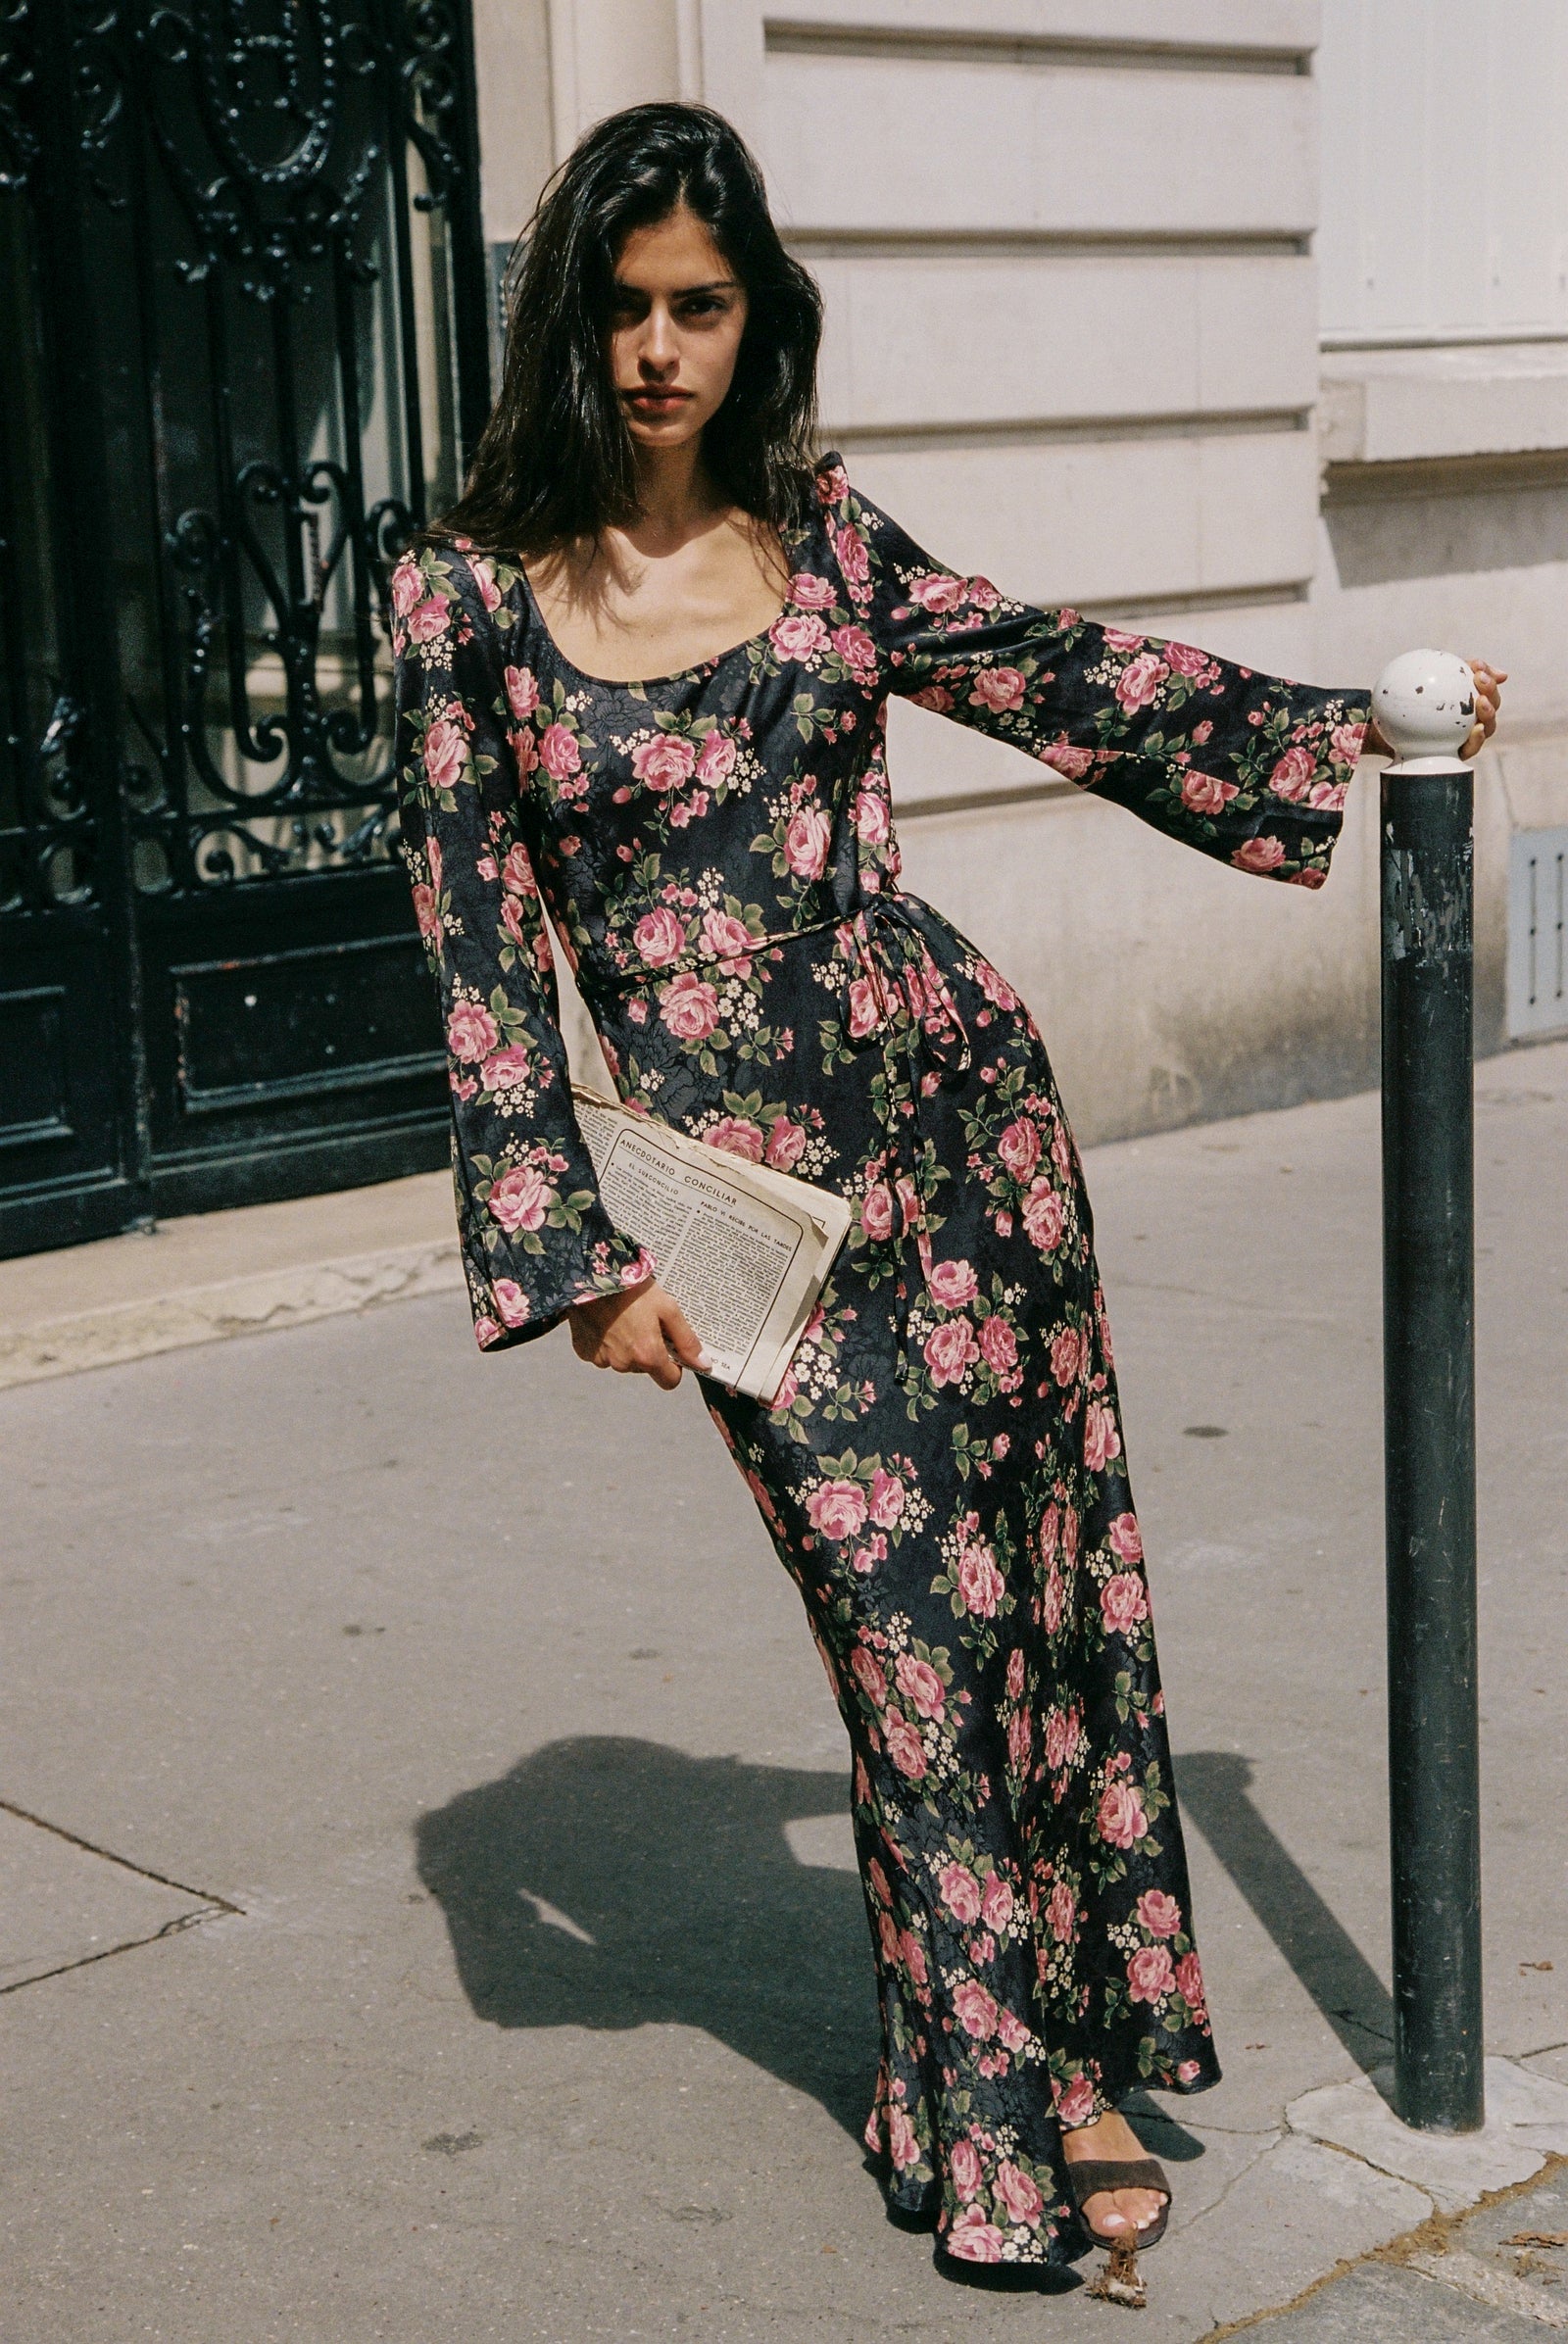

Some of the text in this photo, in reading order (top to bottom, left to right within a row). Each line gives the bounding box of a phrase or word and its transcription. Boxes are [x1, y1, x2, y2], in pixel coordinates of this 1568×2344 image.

[621, 1140, 675, 1175] ANECDOTARIO
[684, 1176, 737, 1205] CONCILIAR
[700, 1201, 718, 1212] PABLO
[760, 1231, 771, 1240] LAS
[773, 1239, 792, 1252] TARDES
